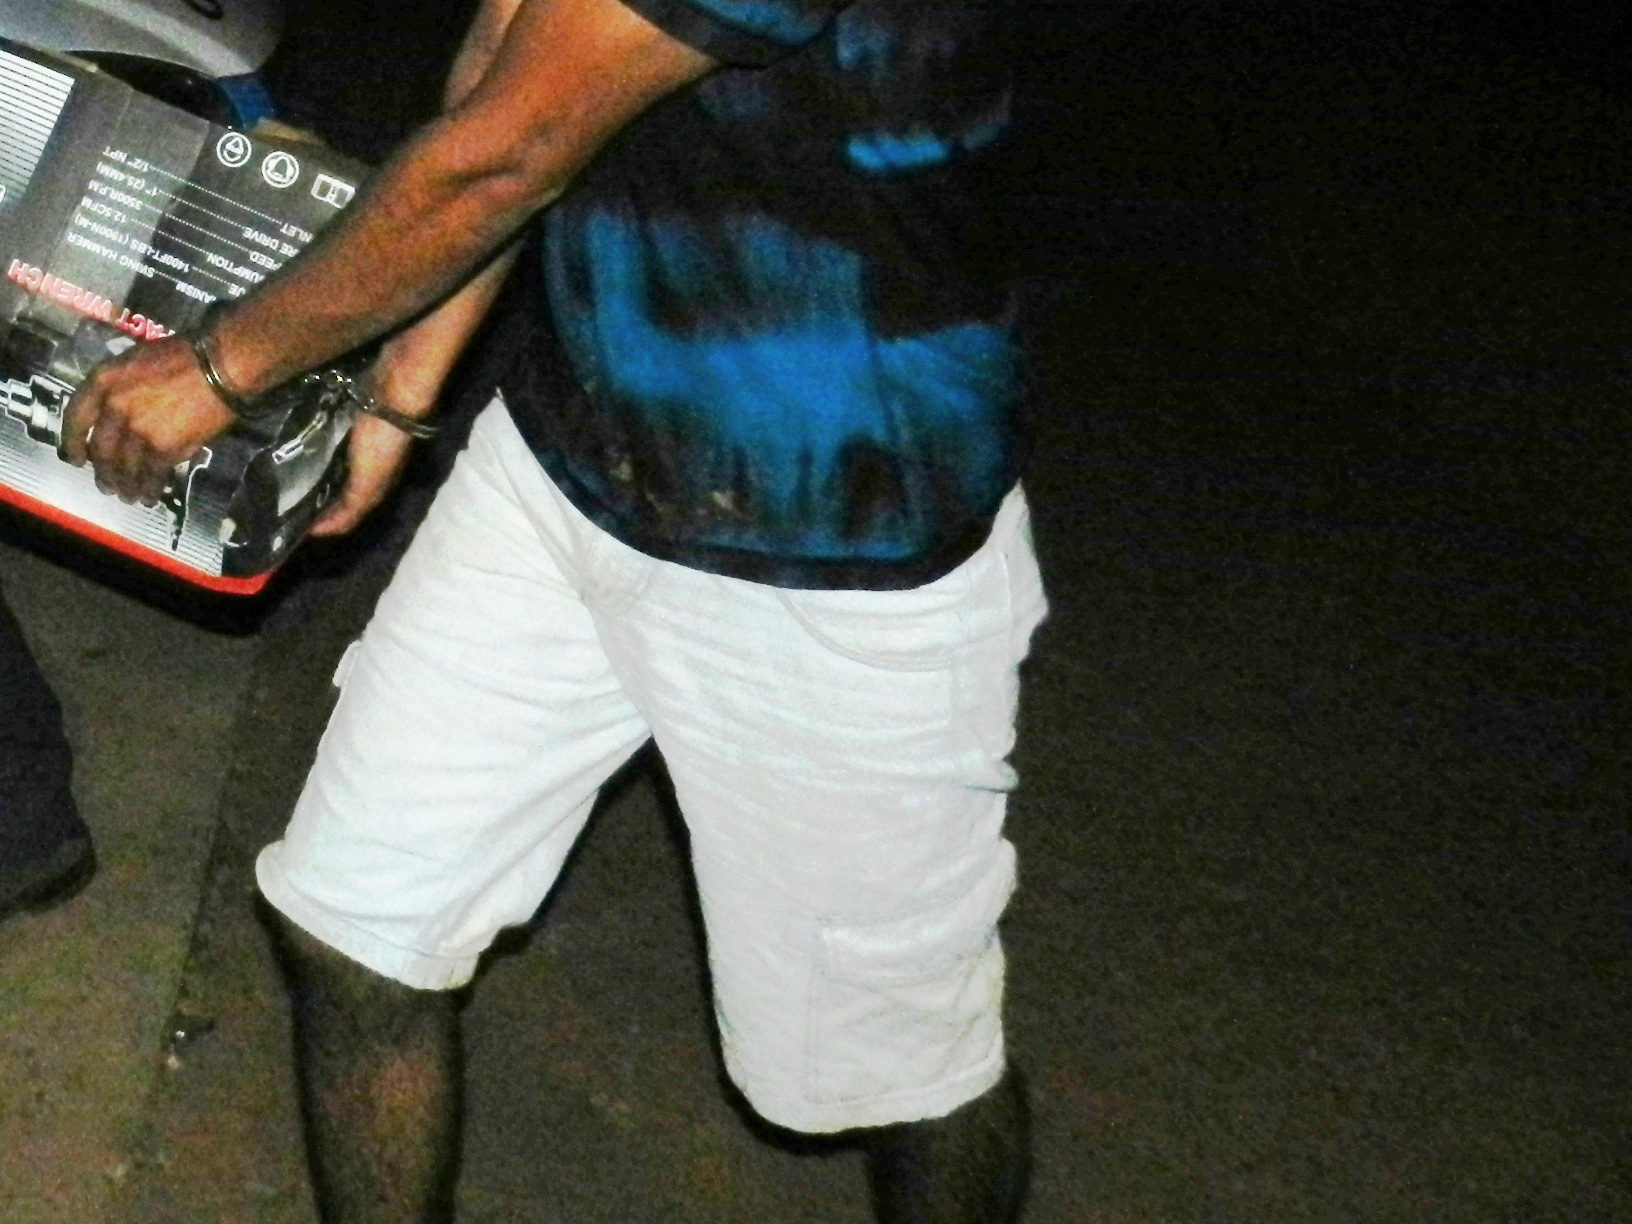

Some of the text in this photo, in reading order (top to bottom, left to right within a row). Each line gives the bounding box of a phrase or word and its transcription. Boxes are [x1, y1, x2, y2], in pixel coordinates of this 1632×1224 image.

[103, 145, 128, 163] NPT
[242, 226, 280, 251] DRIVE
[66, 231, 217, 304] ANISM SWING HAMMER
[206, 252, 266, 284] UMPTION
[8, 258, 176, 342] ACT WRENCH
